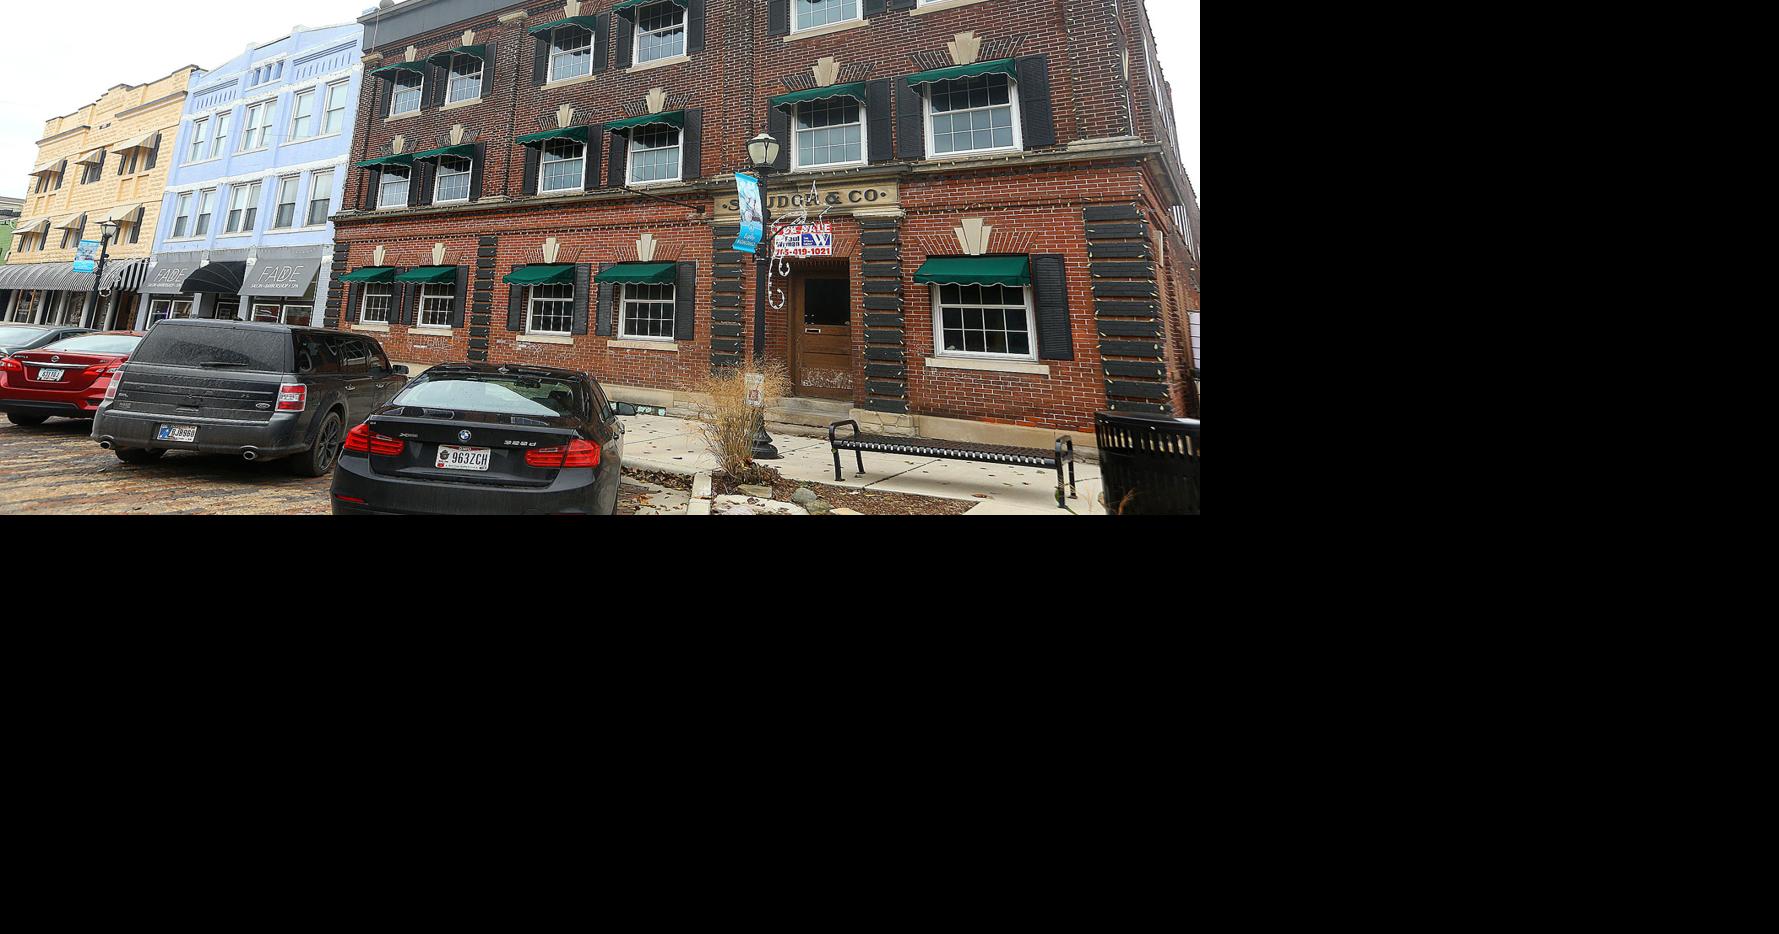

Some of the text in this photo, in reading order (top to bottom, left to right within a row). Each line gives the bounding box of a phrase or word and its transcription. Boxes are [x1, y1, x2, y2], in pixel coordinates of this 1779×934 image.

[154, 268, 188, 282] FADE
[258, 265, 304, 282] FADE
[451, 451, 488, 465] 963ZCH
